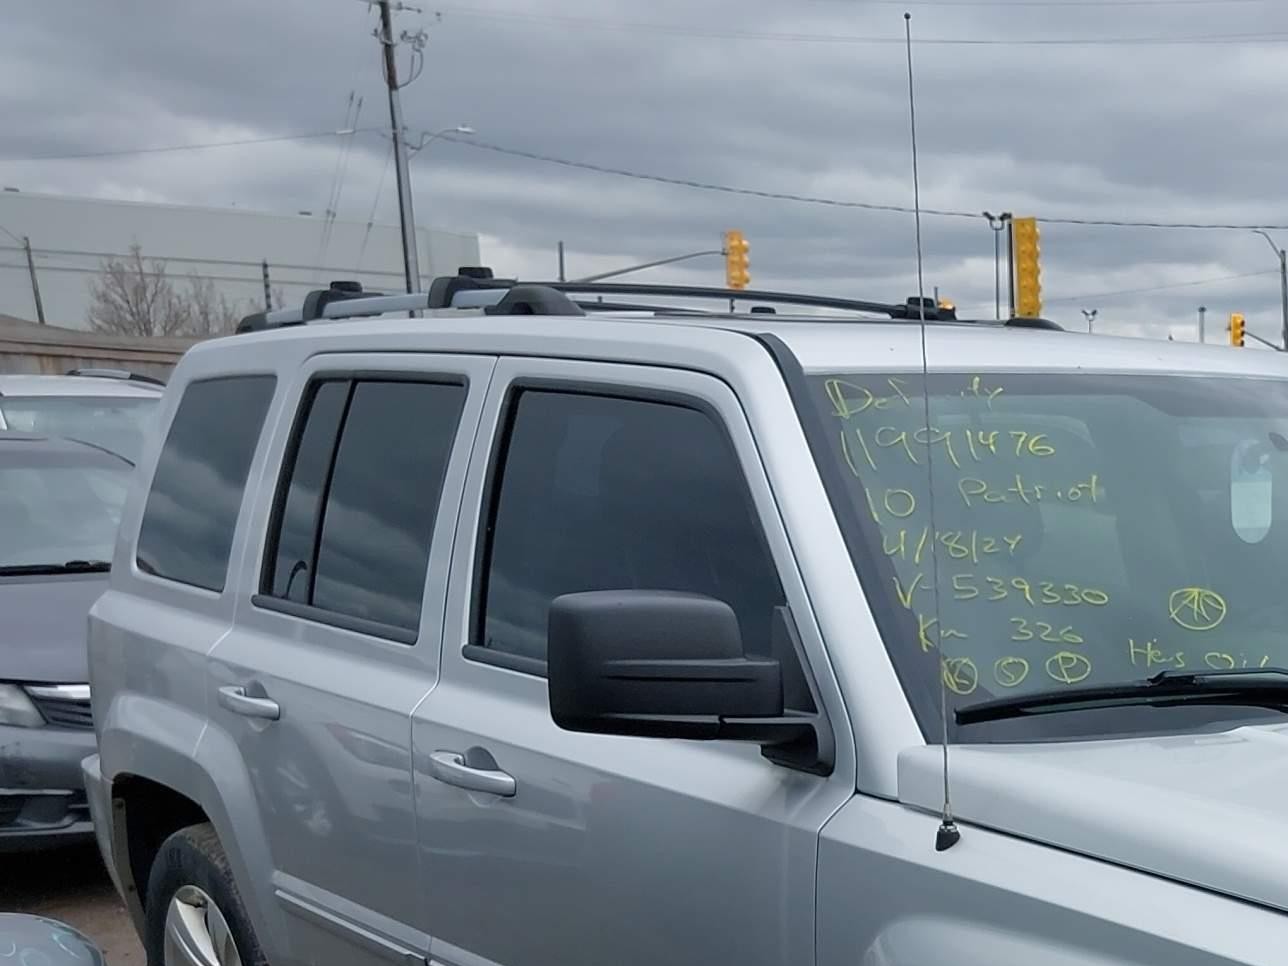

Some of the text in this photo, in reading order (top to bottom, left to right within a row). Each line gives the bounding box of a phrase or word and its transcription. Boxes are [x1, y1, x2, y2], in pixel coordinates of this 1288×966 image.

[841, 426, 1055, 477] 11991476
[865, 474, 1098, 524] 10 Patriot
[952, 574, 1109, 605] 539330
[1010, 618, 1083, 643] 326
